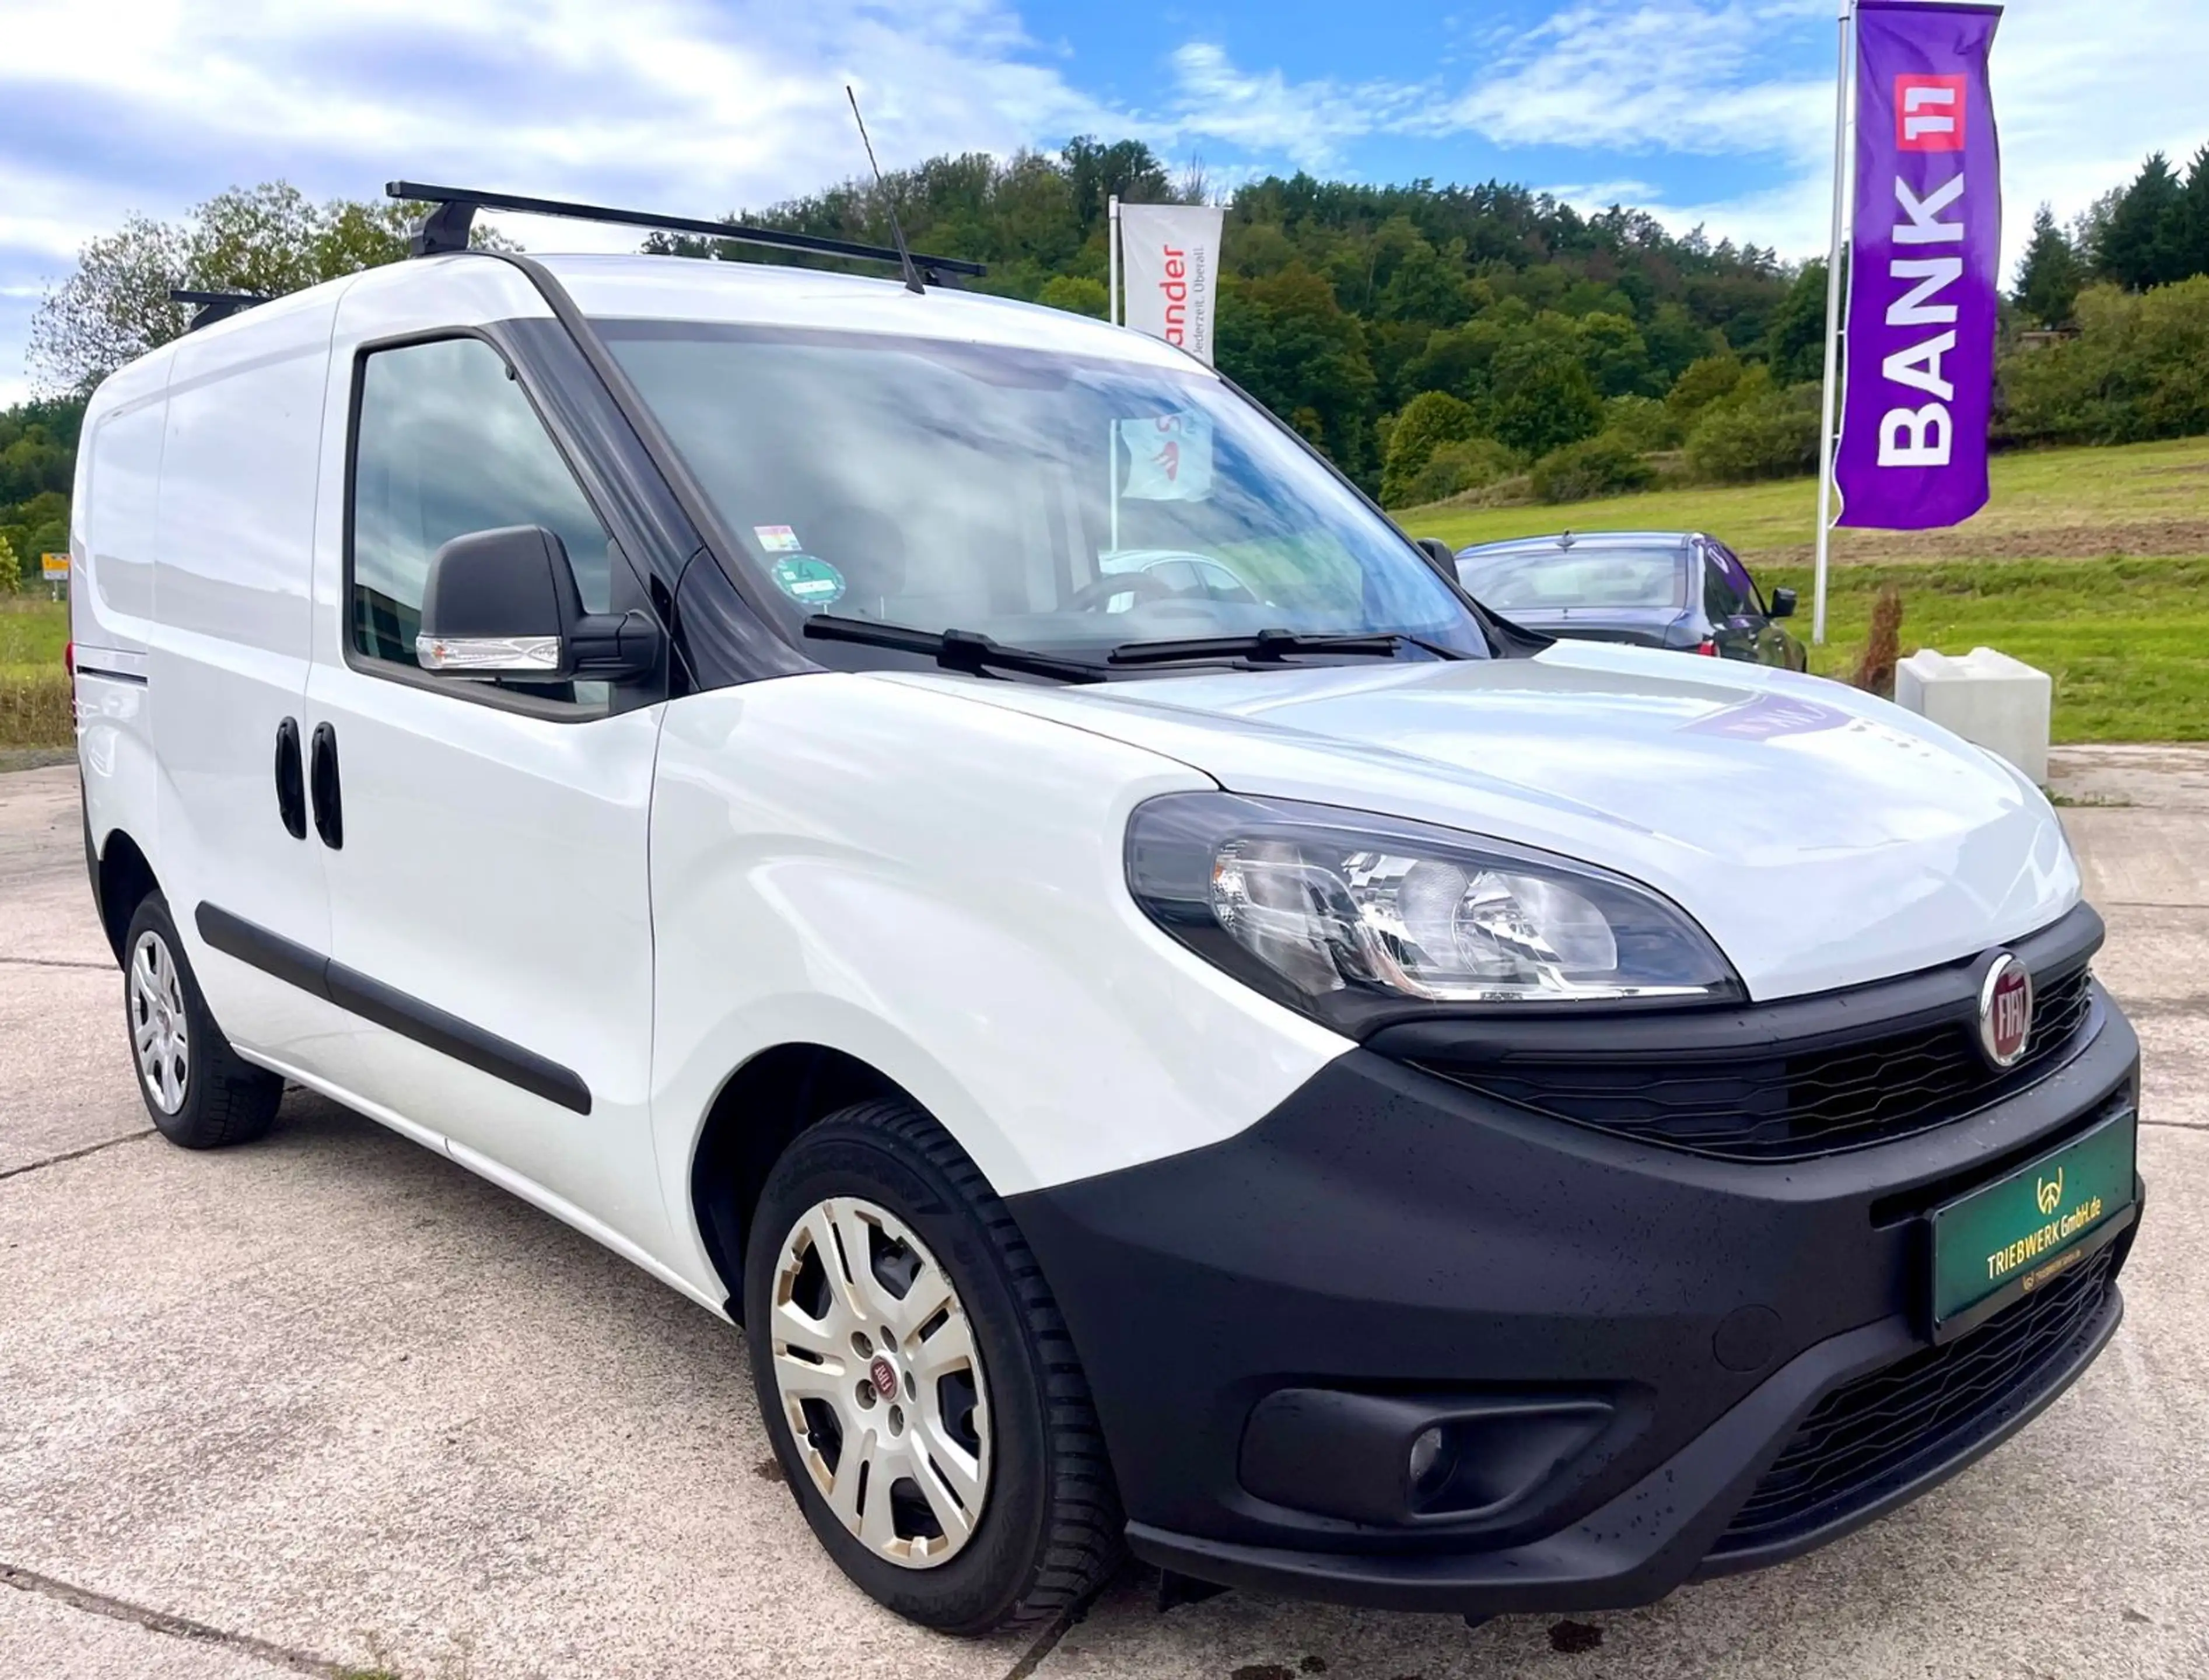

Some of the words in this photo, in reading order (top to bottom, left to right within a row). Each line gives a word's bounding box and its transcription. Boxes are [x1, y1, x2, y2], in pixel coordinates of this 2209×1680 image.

[1903, 87, 1956, 141] 11
[1159, 244, 1187, 346] ander
[1877, 172, 1965, 467] BANK
[1997, 985, 2025, 1041] FIAT
[1987, 1219, 2060, 1280] TRIEBWERK
[2060, 1195, 2101, 1238] GmbH.de
[874, 1364, 892, 1392] FIAT
